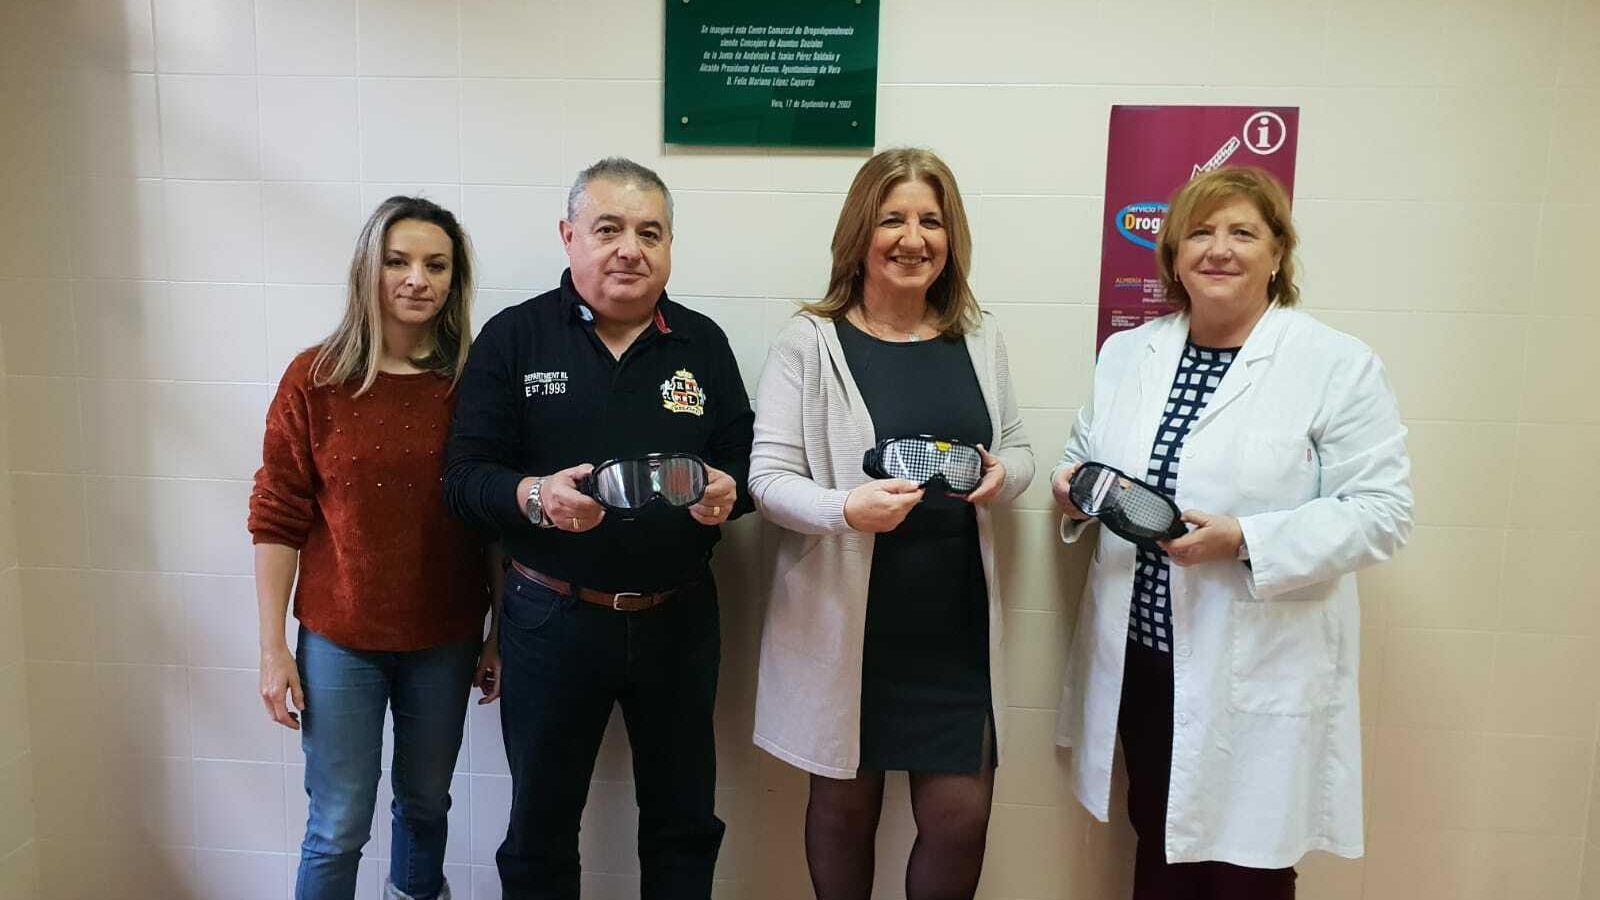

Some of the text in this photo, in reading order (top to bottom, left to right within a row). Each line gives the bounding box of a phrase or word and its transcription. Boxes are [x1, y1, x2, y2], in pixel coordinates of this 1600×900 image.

[701, 25, 709, 34] Se
[736, 26, 747, 34] este
[748, 25, 767, 34] Centro
[768, 26, 795, 35] Comarcal
[795, 26, 803, 35] de
[720, 38, 824, 49] siendo Consejero de Asuntos Sociales
[703, 51, 711, 60] de
[712, 51, 718, 60] la
[718, 51, 734, 60] Junta
[735, 51, 742, 60] de
[770, 51, 777, 60] D.
[796, 51, 812, 61] Pérez
[699, 64, 720, 73] Alcalde
[721, 64, 750, 73] Presidente
[750, 64, 760, 73] del
[781, 64, 818, 75] Ayuntamiento
[819, 65, 827, 74] de
[828, 65, 842, 75] Vera
[726, 76, 732, 86] D.
[748, 77, 771, 86] Mariano
[772, 77, 789, 88] López
[785, 99, 793, 109] 17
[794, 100, 801, 109] de
[801, 99, 829, 110] Septiembre
[830, 100, 837, 109] de
[1125, 213, 1164, 234] Drog
[525, 384, 540, 397] EST
